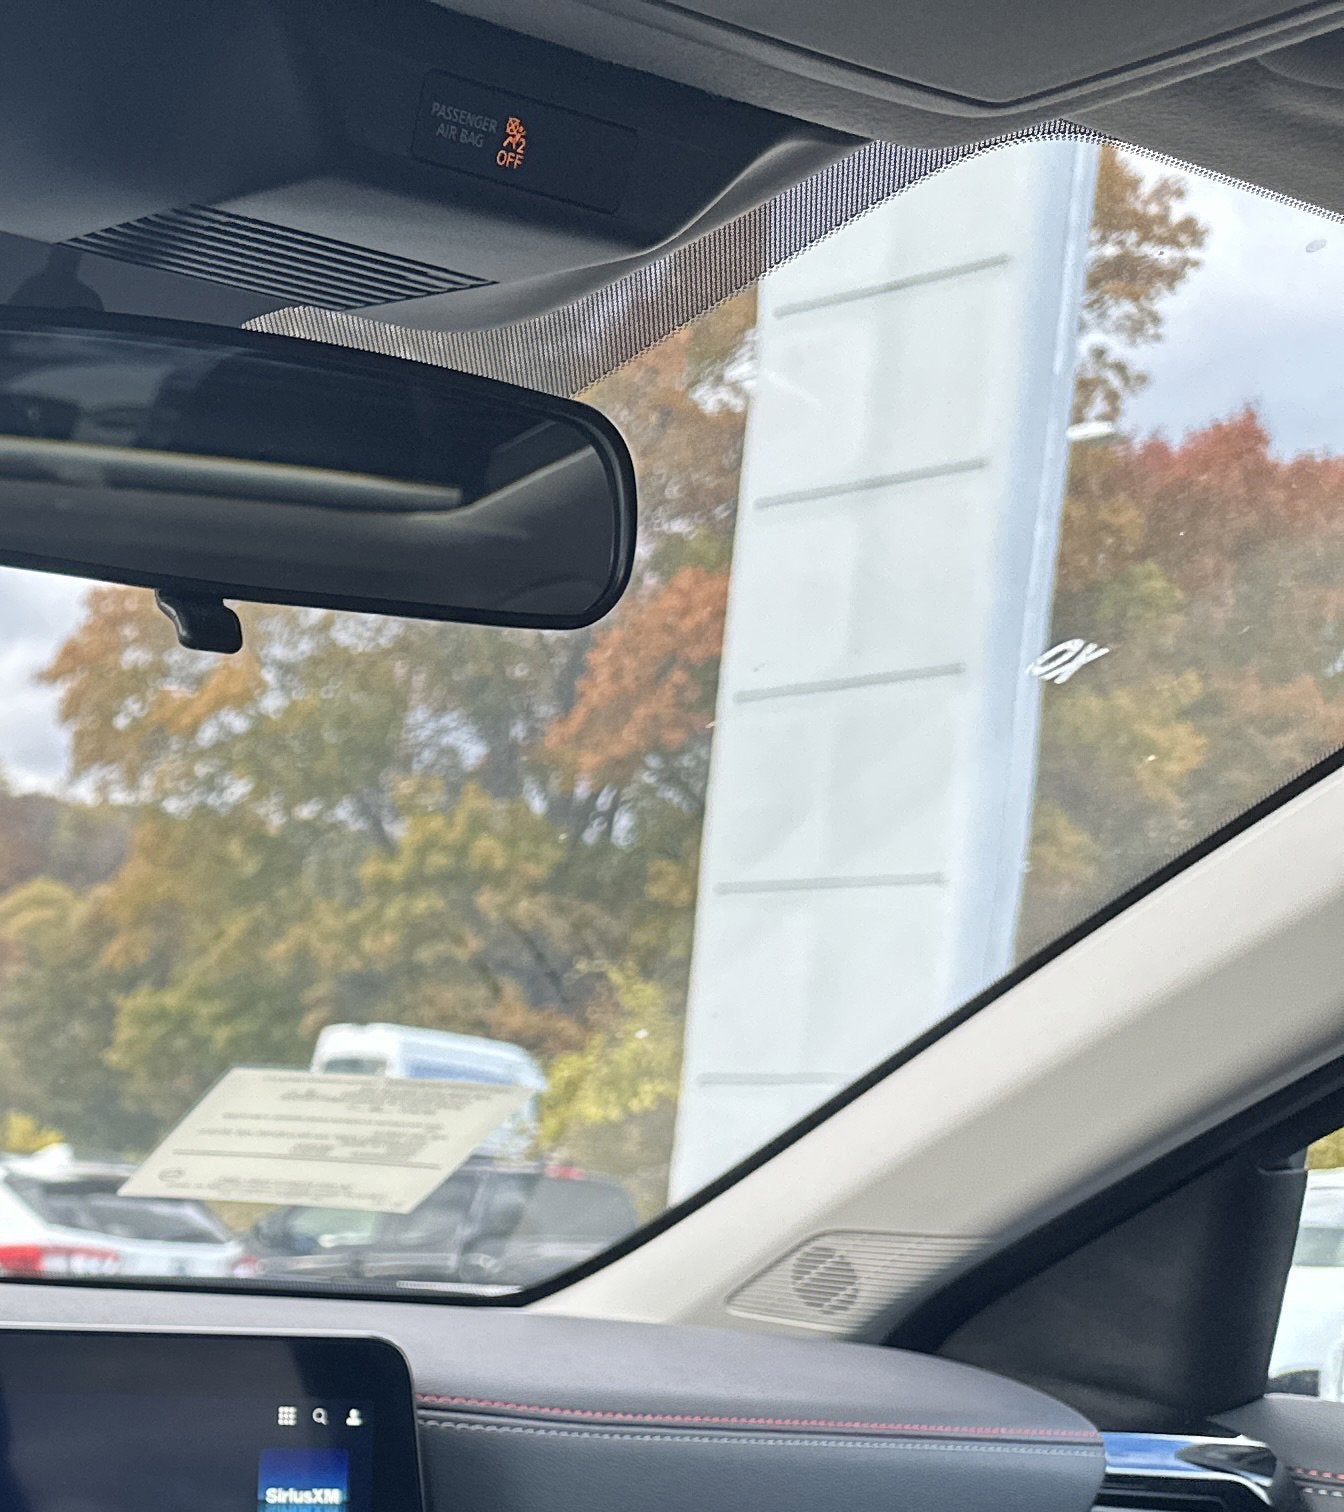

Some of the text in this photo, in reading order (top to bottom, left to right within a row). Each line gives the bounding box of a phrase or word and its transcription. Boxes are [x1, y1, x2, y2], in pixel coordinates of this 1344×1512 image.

[431, 102, 499, 133] PASSENGER
[435, 122, 484, 148] AIR BAG
[496, 150, 525, 170] OFF
[265, 1487, 342, 1506] SiriusXM
